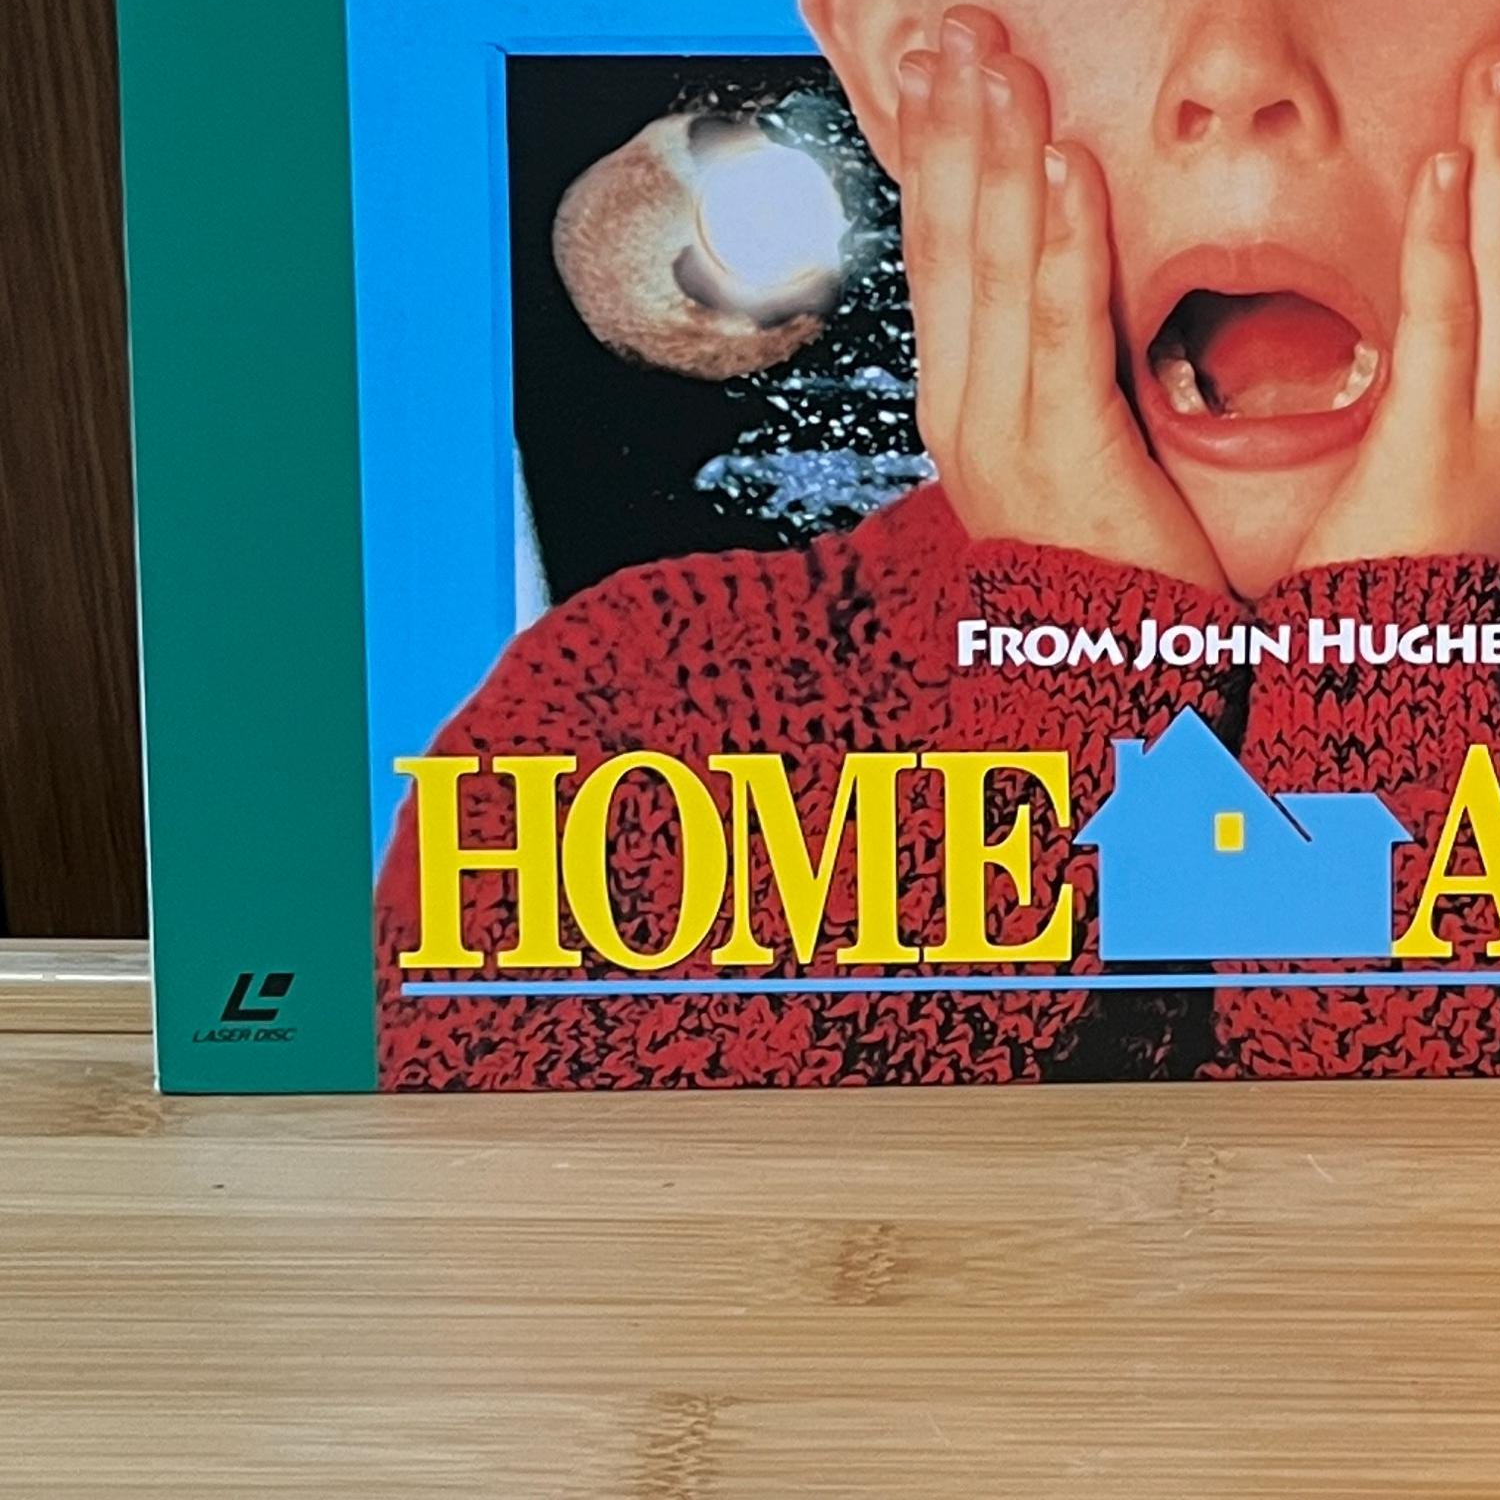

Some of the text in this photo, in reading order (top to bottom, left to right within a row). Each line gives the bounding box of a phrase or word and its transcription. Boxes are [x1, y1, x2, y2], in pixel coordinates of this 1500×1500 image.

[957, 619, 1123, 667] FROM
[1133, 619, 1291, 671] JOHN
[394, 750, 1074, 972] HOME
[192, 1028, 297, 1044] LASER DISC
